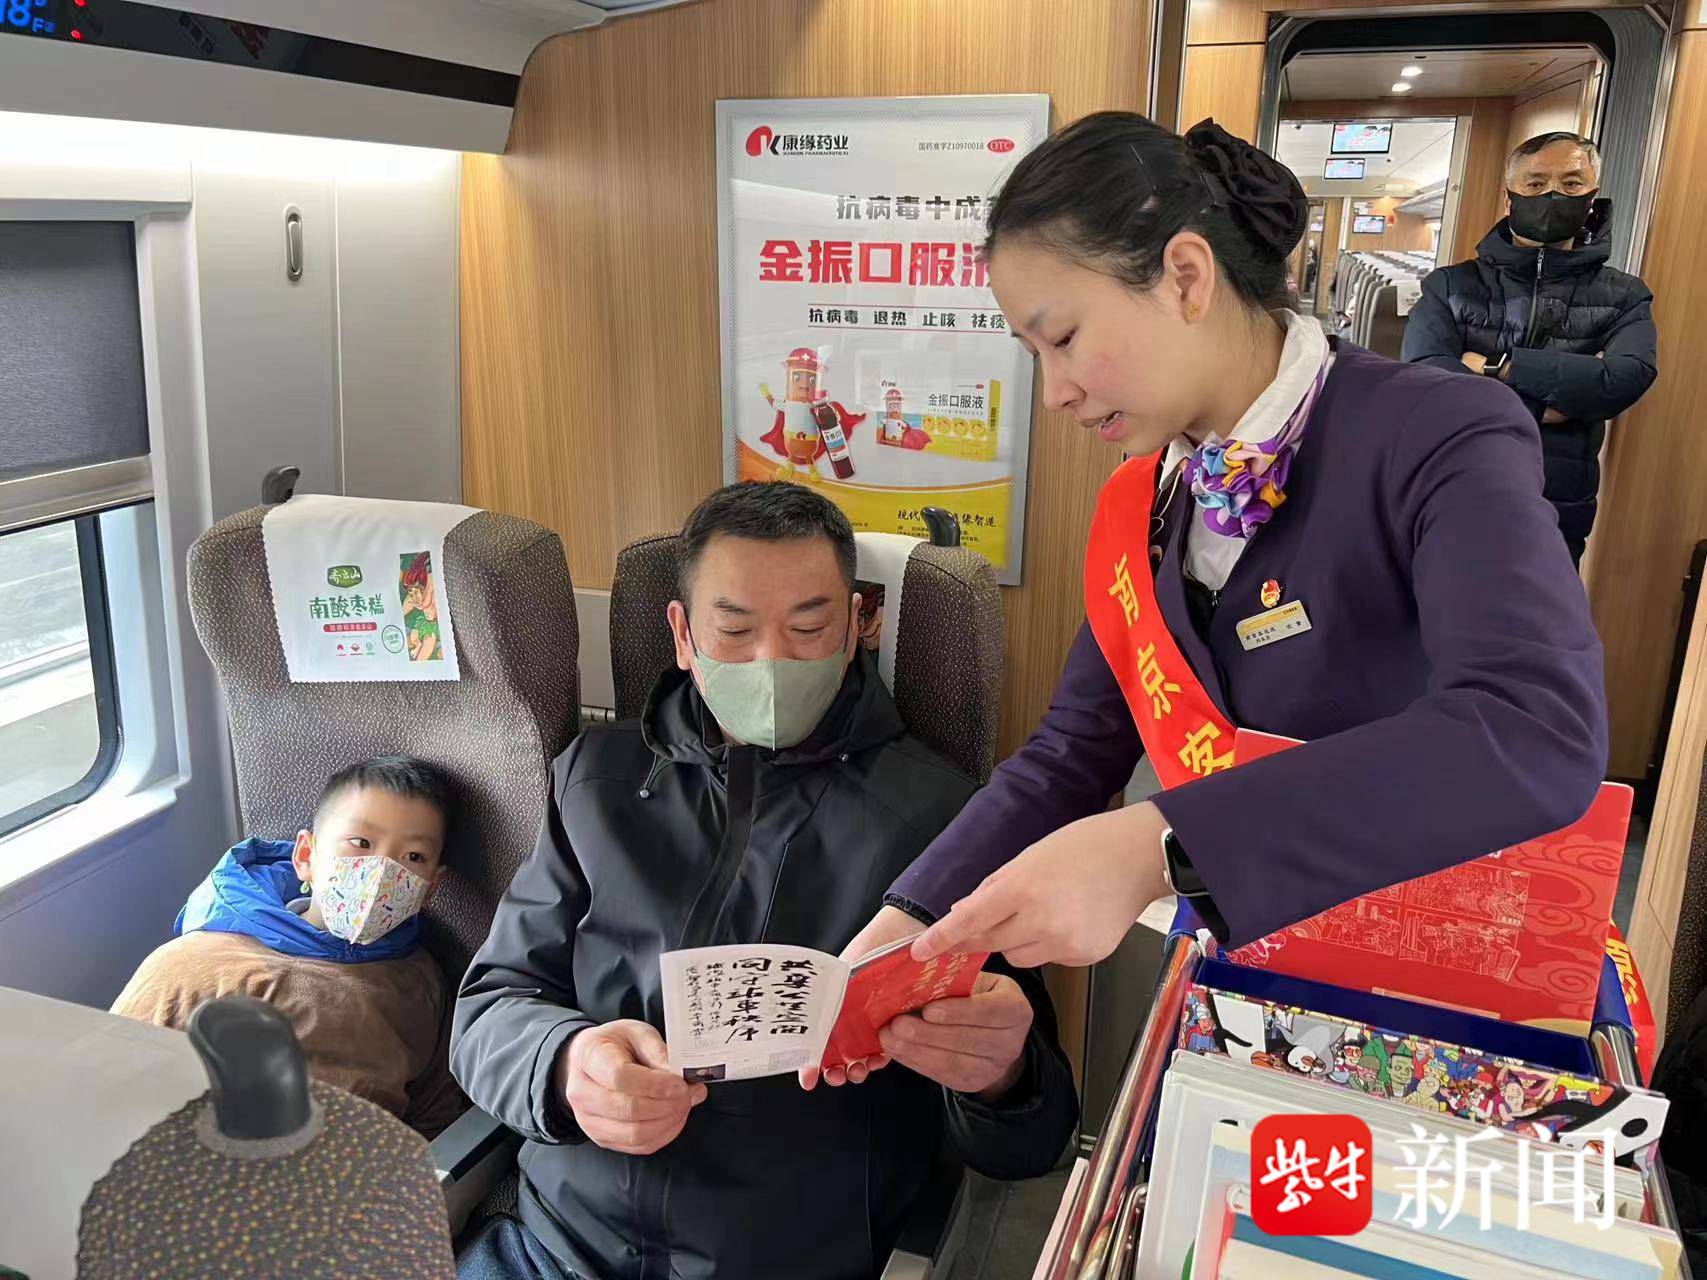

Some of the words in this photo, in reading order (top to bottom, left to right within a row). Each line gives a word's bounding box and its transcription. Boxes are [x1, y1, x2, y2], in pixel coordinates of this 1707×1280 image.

[782, 134, 849, 151] 康缘药业
[918, 142, 984, 152] 国药准字Z10970018
[990, 141, 1012, 152] OTC
[808, 308, 859, 325] 抗病毒
[873, 310, 907, 326] 退热
[922, 311, 957, 328] 止咳
[971, 313, 1006, 329] 祛痰
[928, 393, 984, 410] 金振口服液
[309, 593, 385, 619] 南酸枣糕
